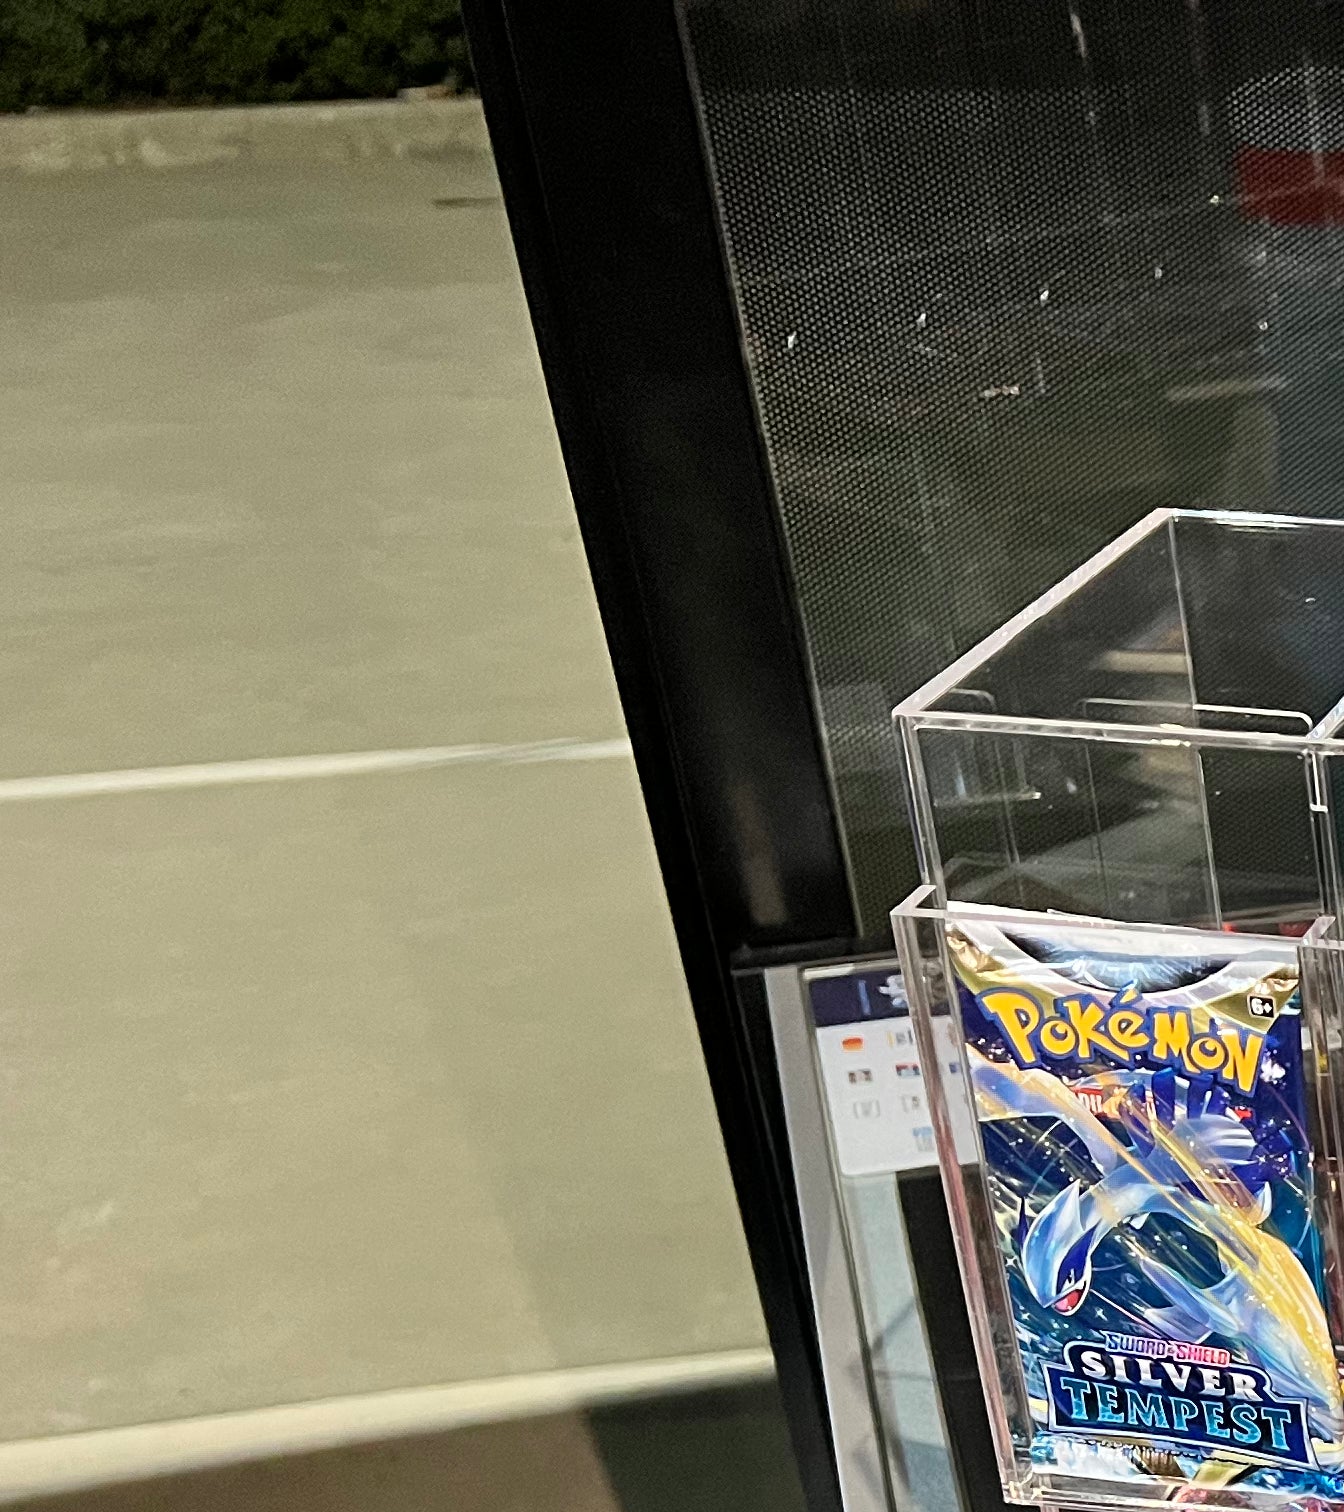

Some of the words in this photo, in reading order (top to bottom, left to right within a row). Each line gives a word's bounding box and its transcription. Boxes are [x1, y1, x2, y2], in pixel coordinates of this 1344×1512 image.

[1250, 997, 1274, 1016] 6+
[1078, 1349, 1265, 1402] SILVER
[1056, 1376, 1296, 1451] TEMPEST
